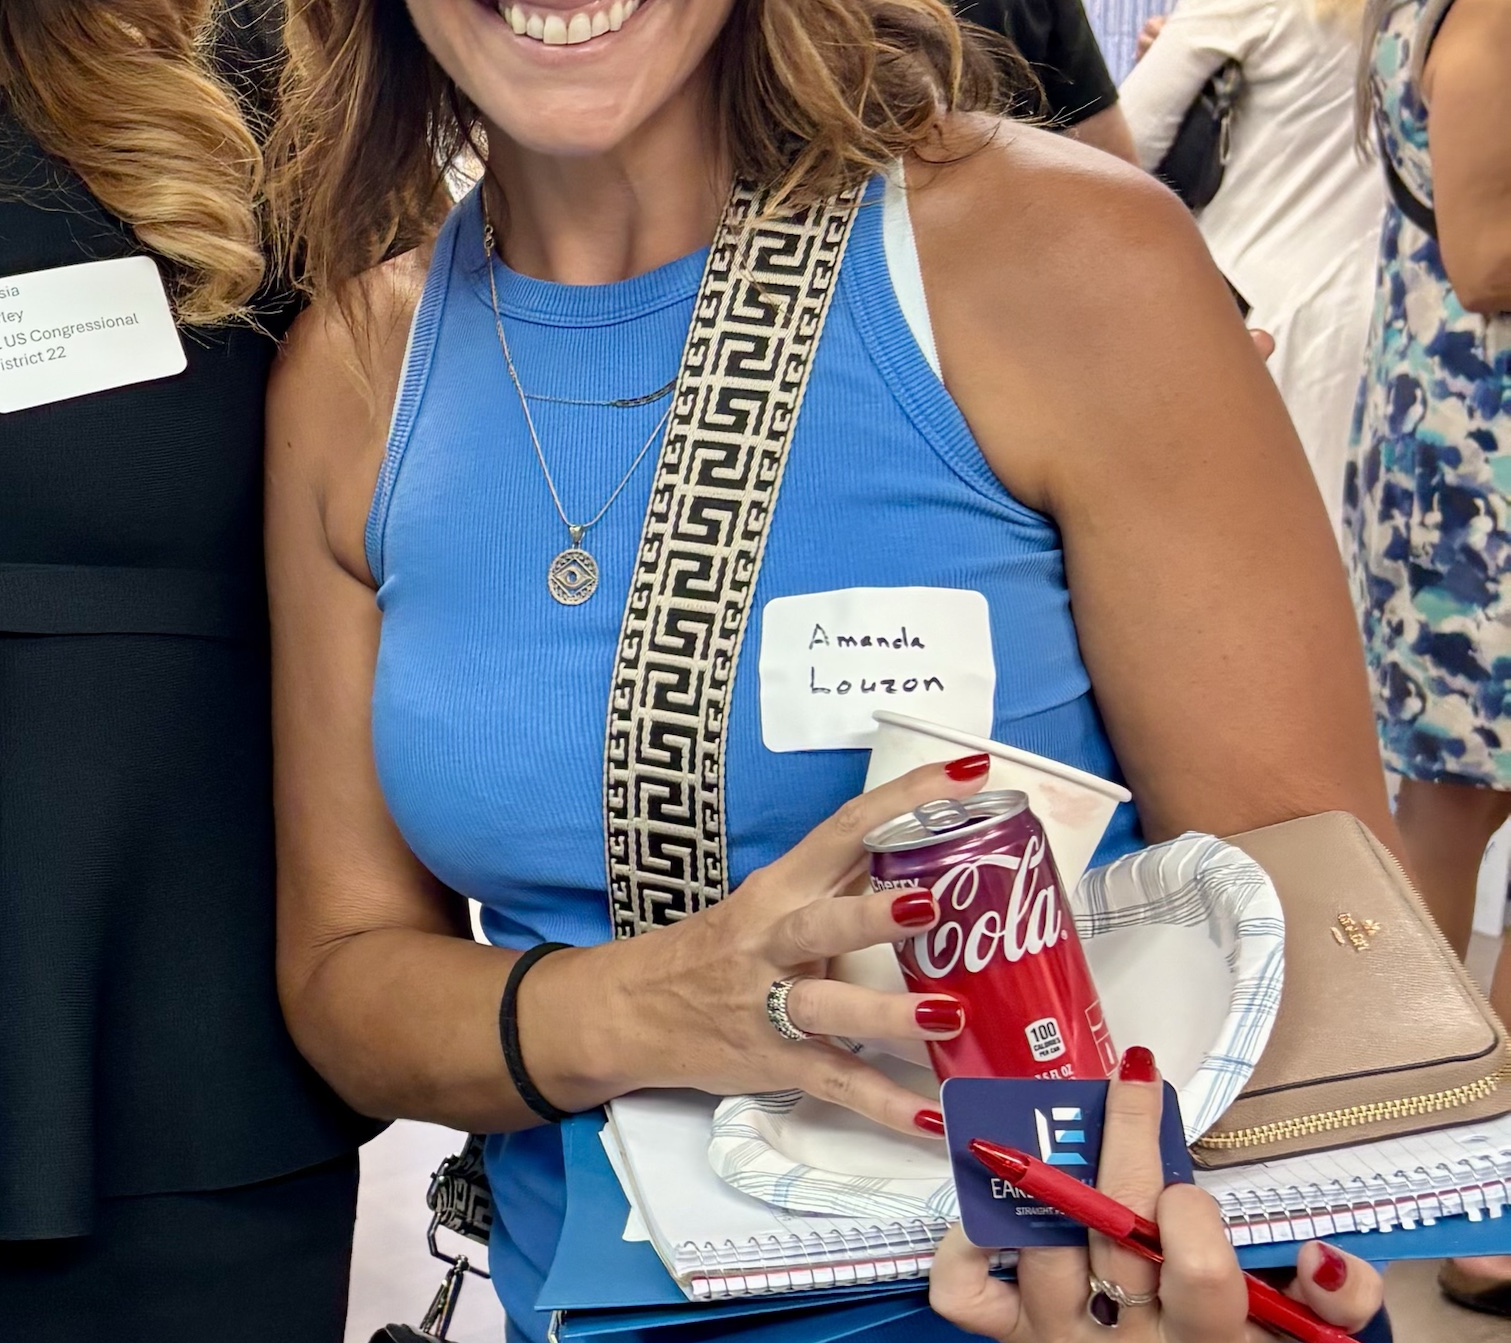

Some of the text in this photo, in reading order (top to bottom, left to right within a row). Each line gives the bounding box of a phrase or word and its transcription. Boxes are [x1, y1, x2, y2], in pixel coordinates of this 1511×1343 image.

[4, 333, 27, 348] US
[30, 313, 140, 342] Congressional
[46, 346, 67, 362] 22
[808, 623, 926, 650] Amanda
[809, 666, 945, 695] Louzon
[870, 876, 920, 894] Cherry
[913, 835, 1062, 979] Cola
[1030, 1021, 1057, 1043] 100
[991, 1178, 1034, 1199] EA
